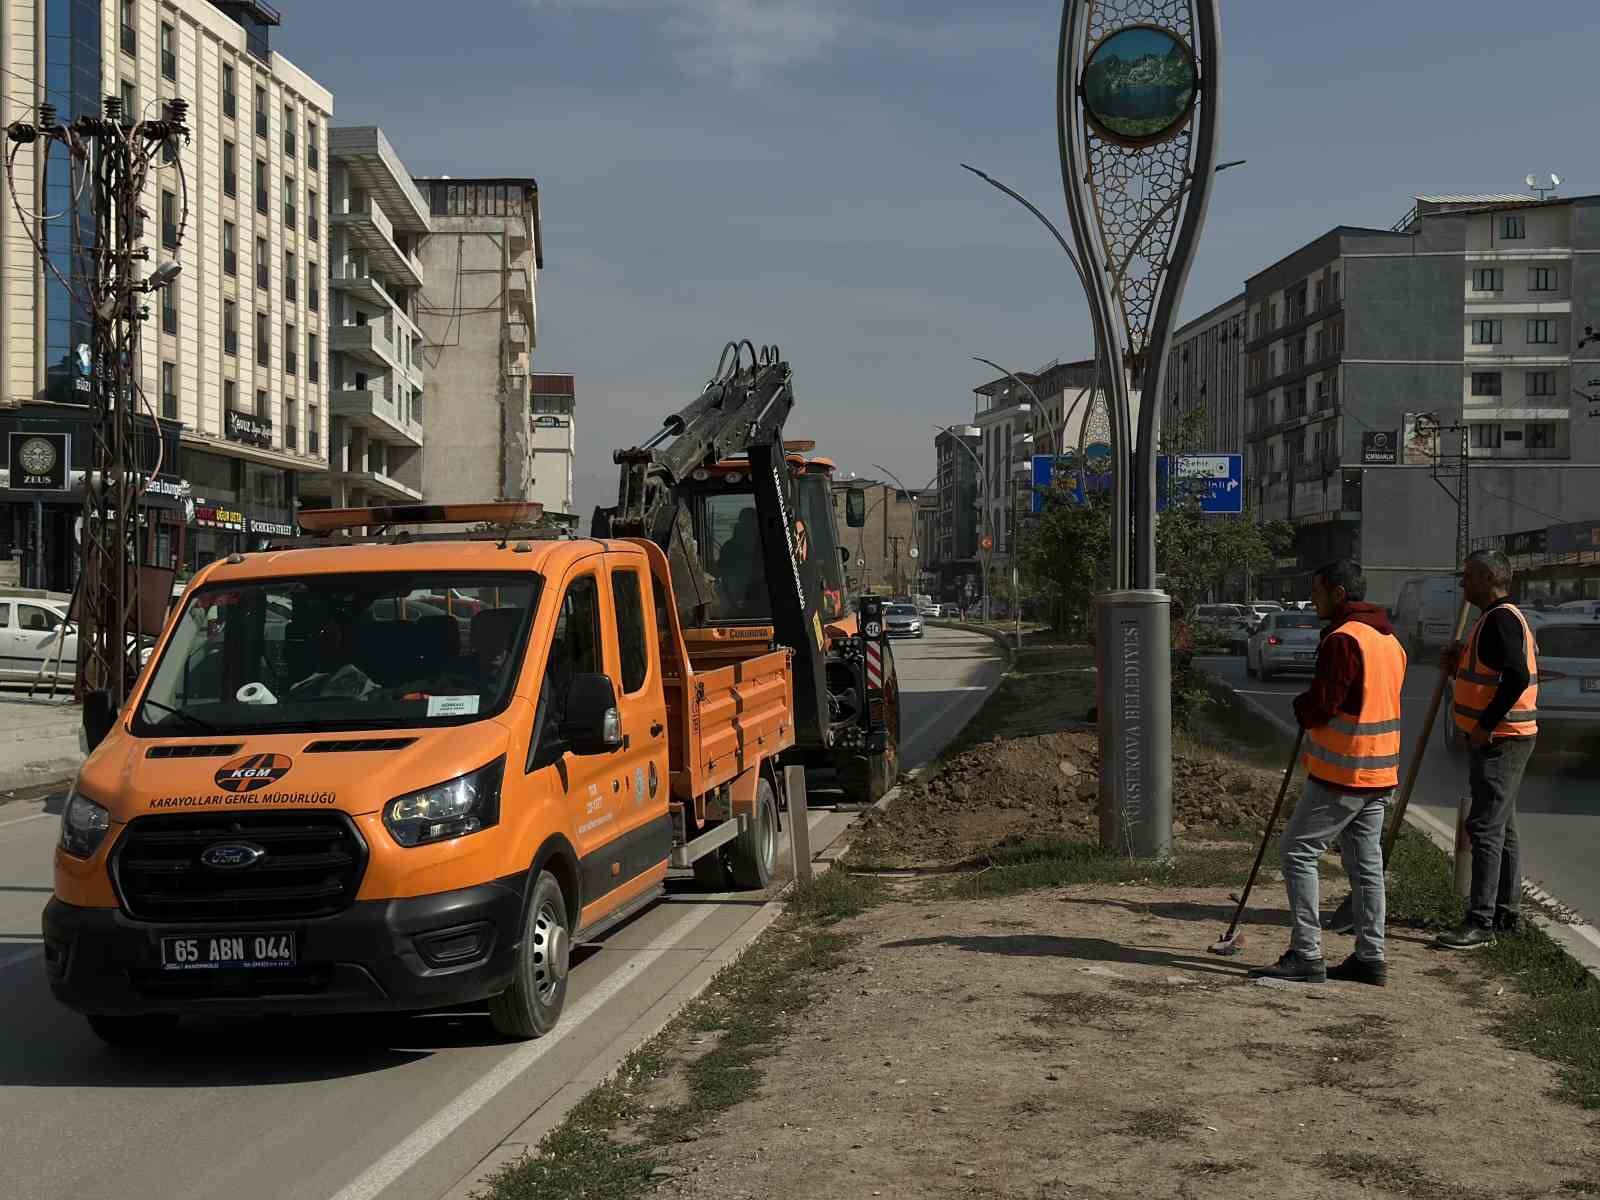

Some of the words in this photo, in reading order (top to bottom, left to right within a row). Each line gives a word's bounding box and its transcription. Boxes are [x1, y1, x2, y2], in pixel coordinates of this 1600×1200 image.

[23, 475, 52, 484] ZEUS
[231, 768, 272, 778] KGM
[149, 795, 224, 809] KARAYOLLARI
[224, 793, 259, 805] GENEL
[262, 791, 336, 805] MÜDÜRLÜĞÜ
[175, 940, 199, 962] 65
[209, 938, 244, 961] ABN
[254, 936, 290, 959] 044
